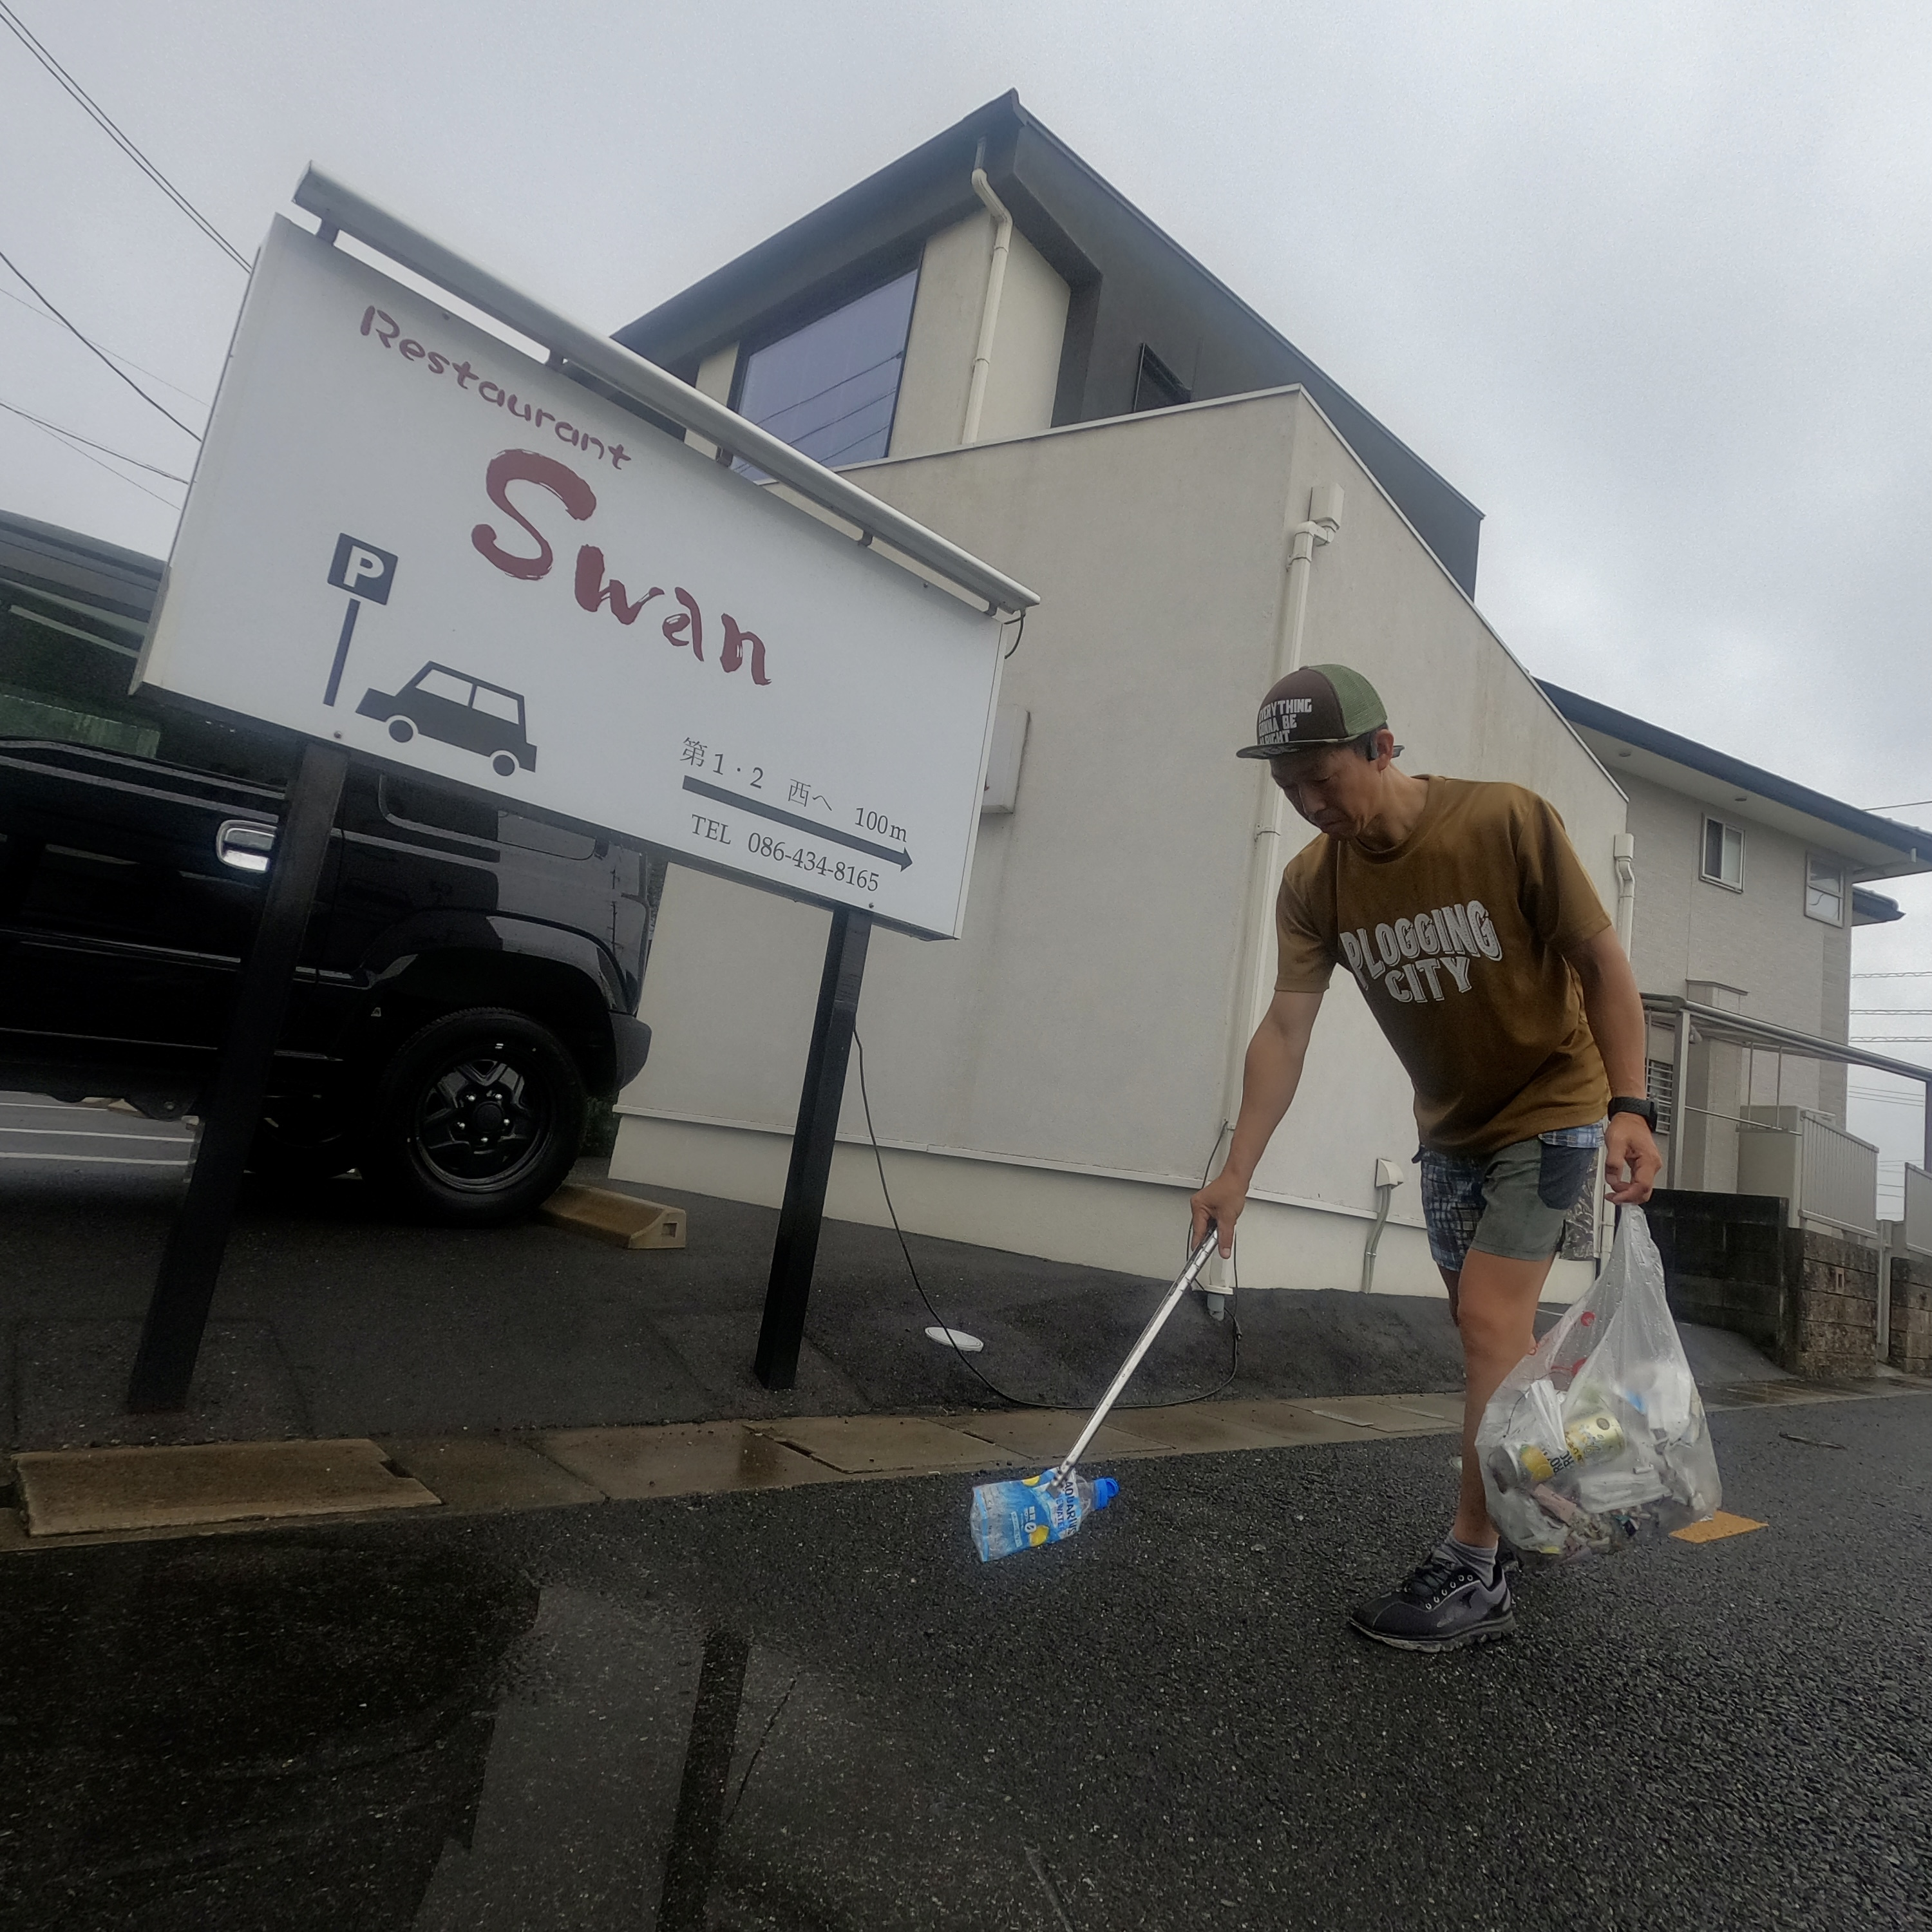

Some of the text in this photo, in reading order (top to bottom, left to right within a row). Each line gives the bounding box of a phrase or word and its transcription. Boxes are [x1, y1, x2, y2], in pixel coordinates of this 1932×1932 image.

[360, 305, 632, 470] Restaurant
[343, 545, 384, 587] P
[471, 449, 772, 686] Swan
[1282, 714, 1297, 730] BE
[788, 779, 833, 811] 西へ
[855, 808, 908, 842] 100m
[692, 814, 880, 891] TEL 086-434-8165
[1340, 900, 1502, 990] PLOGGING
[1385, 956, 1473, 1003] CITY
